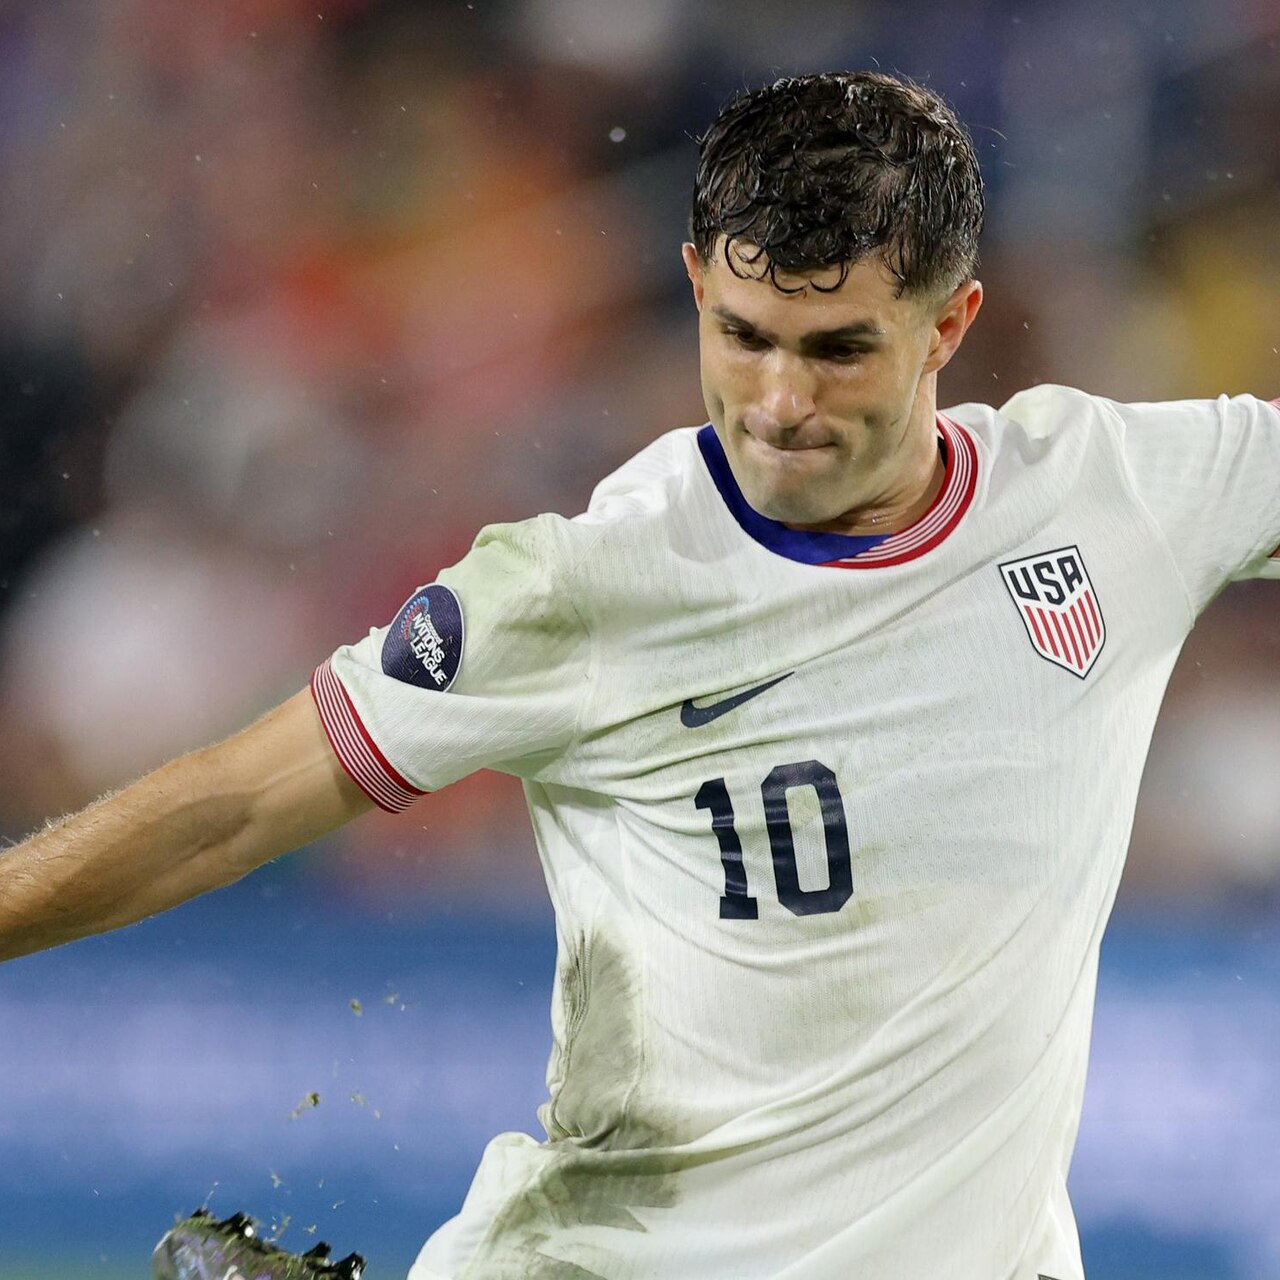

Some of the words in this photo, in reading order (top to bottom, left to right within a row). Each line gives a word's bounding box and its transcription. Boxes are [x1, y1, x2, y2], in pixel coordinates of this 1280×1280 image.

[1008, 555, 1083, 606] USA
[410, 636, 448, 685] LEAGUE
[412, 612, 445, 664] NATIONS
[694, 760, 853, 919] 10
